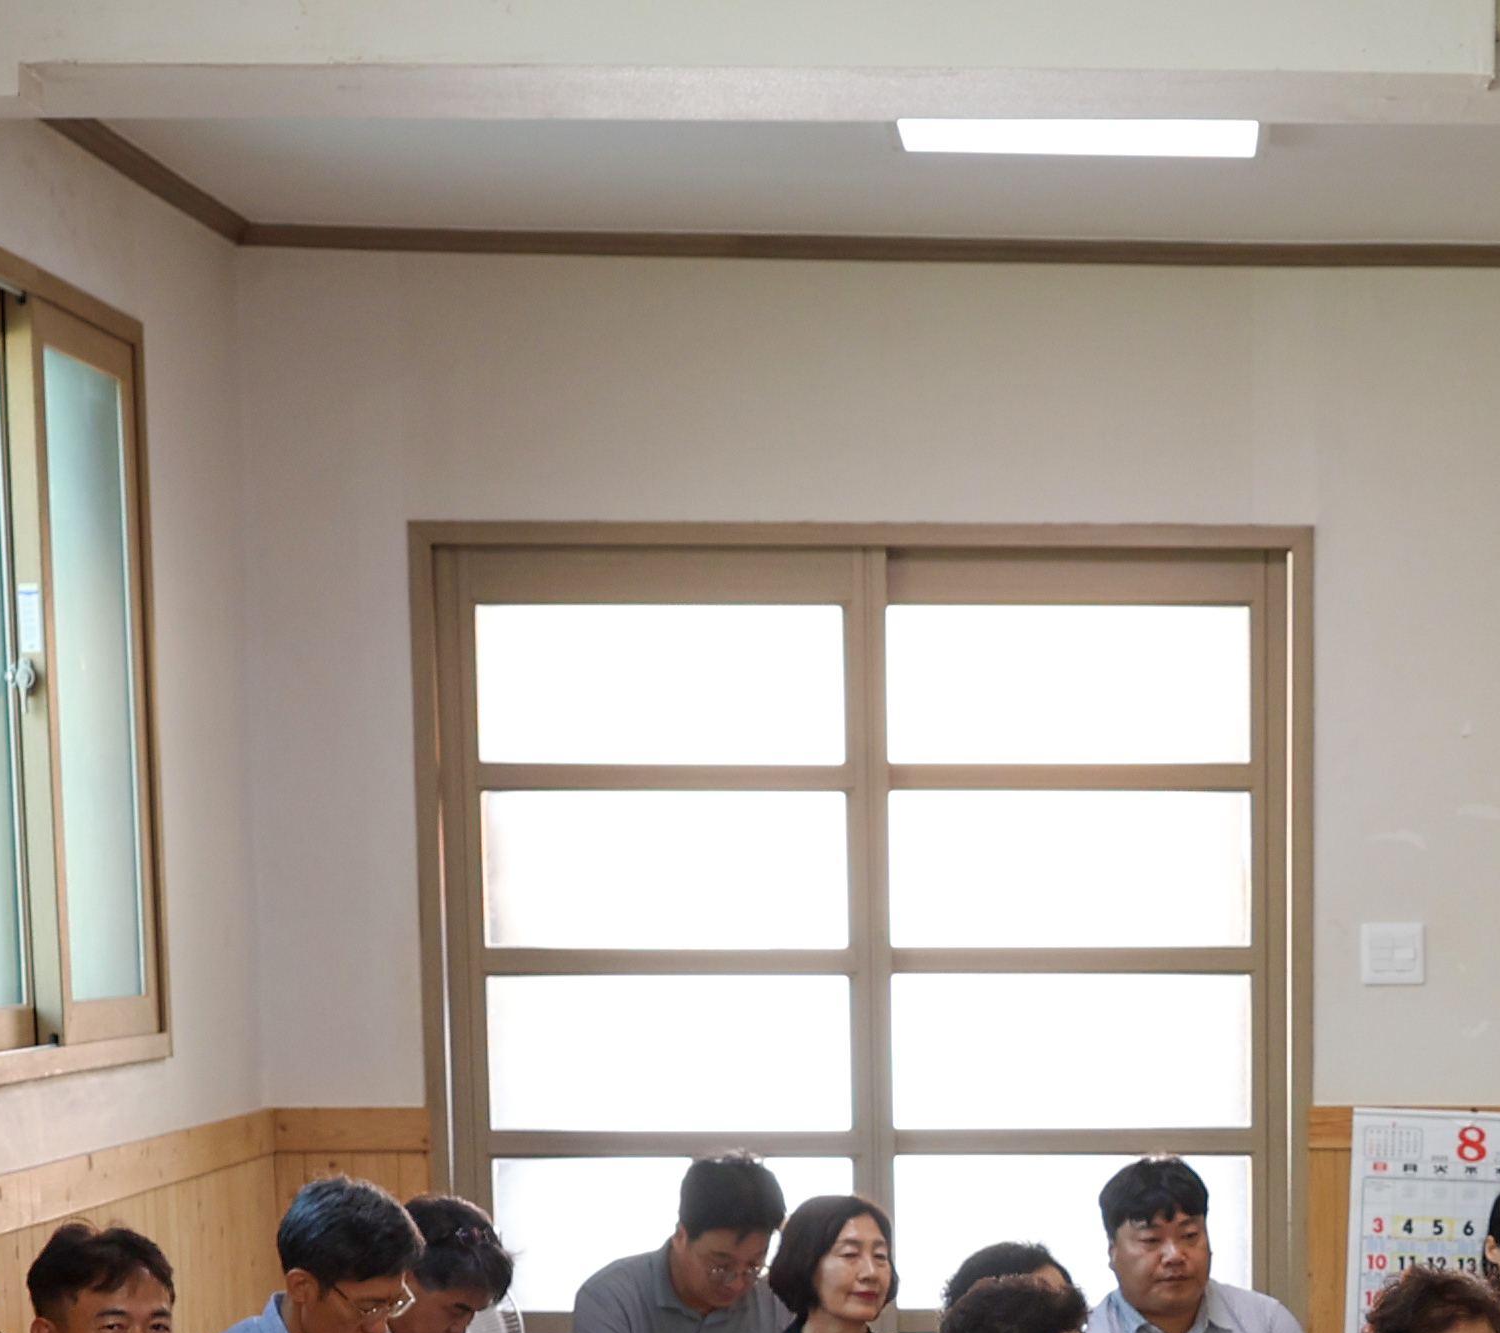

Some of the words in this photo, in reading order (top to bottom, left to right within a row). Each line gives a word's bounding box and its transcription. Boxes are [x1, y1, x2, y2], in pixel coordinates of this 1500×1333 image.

[1457, 1126, 1487, 1163] 8
[1373, 1217, 1383, 1233] 3
[1403, 1219, 1413, 1234] 4
[1433, 1219, 1444, 1235] 5
[1463, 1221, 1474, 1236] 6
[1367, 1254, 1387, 1270] 10
[1398, 1256, 1415, 1270] 11
[1427, 1257, 1446, 1271] 12
[1457, 1257, 1476, 1272] 13
